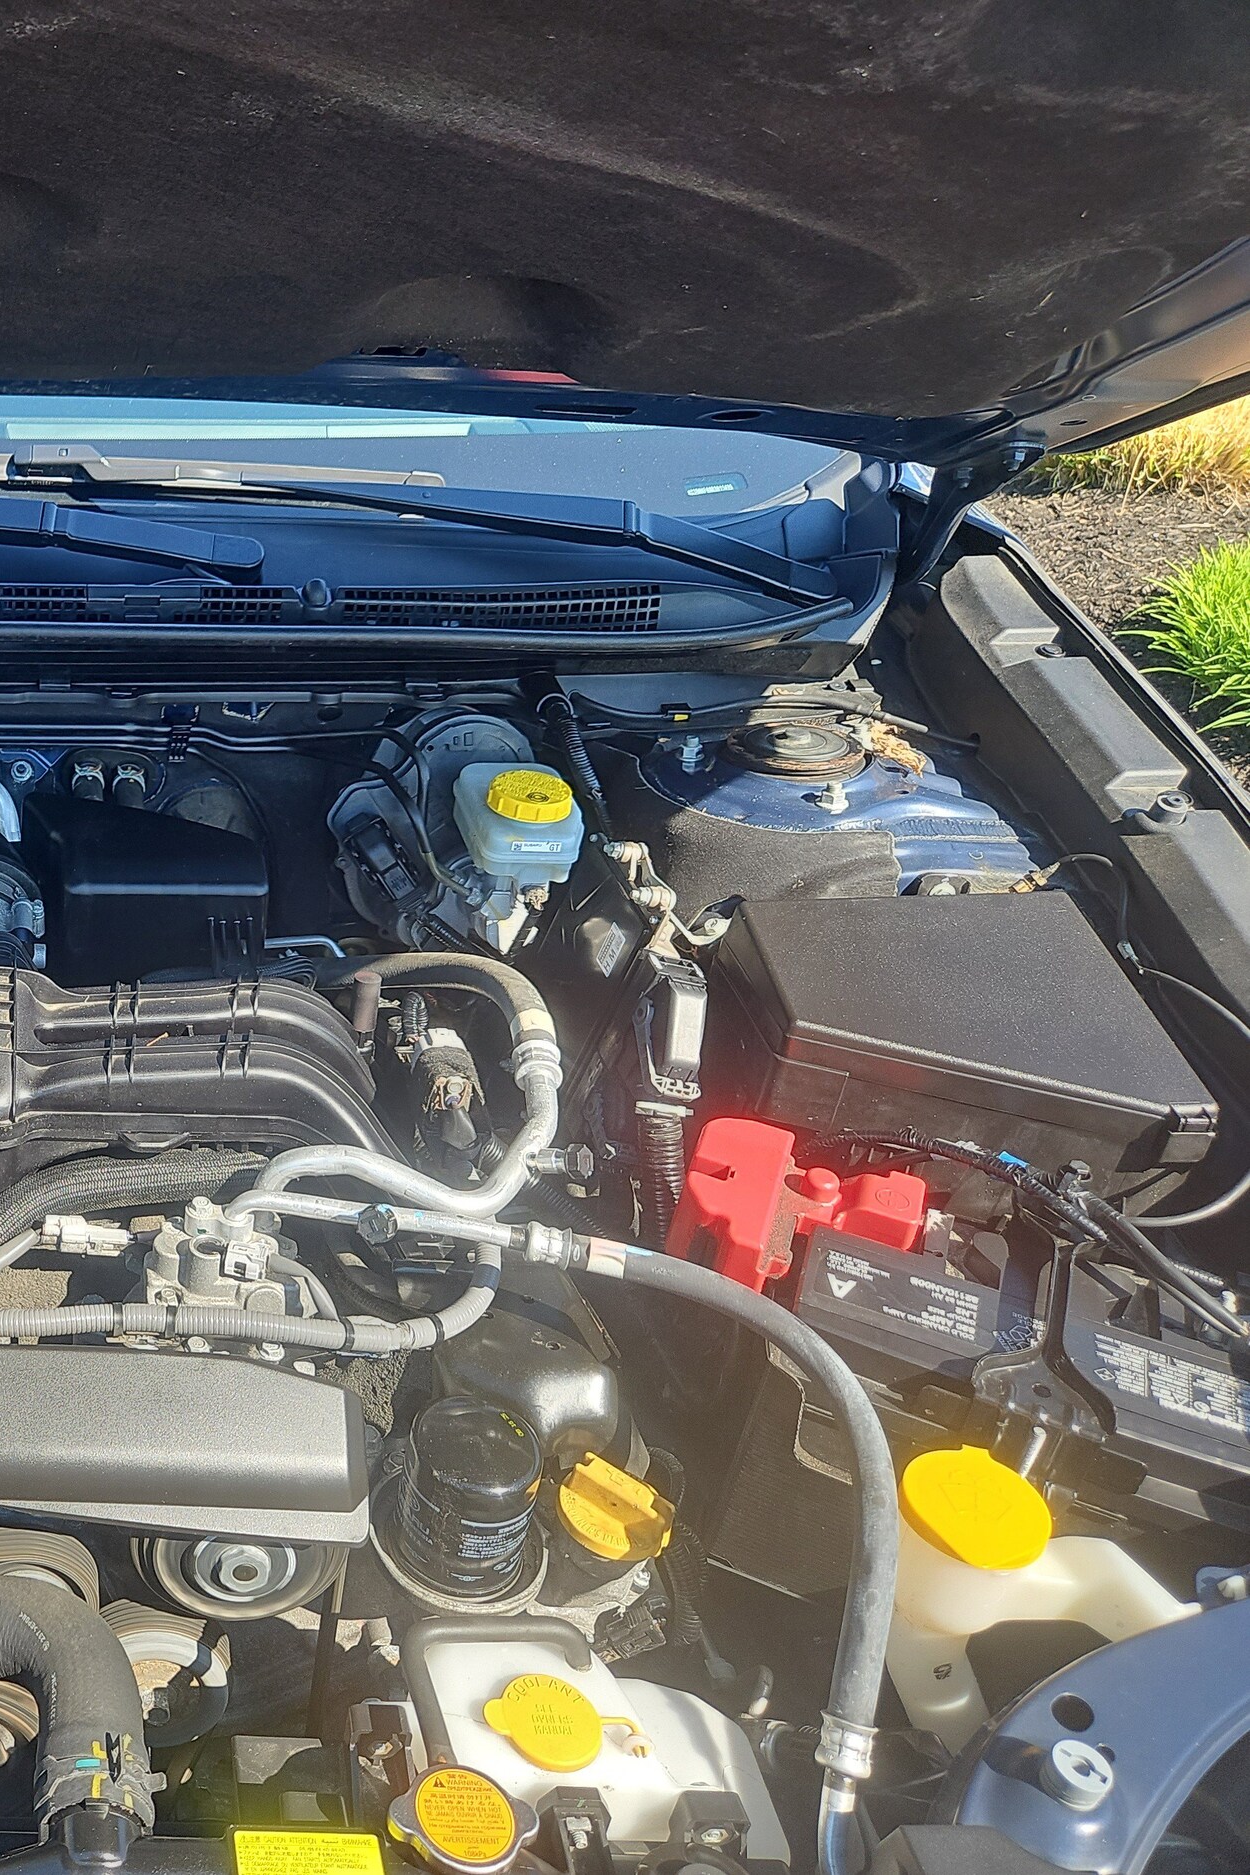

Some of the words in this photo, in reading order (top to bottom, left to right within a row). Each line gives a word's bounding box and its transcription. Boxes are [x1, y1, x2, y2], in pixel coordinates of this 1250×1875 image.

[549, 844, 561, 852] GT
[920, 1311, 954, 1327] AMPS
[446, 1779, 483, 1787] WARNING
[442, 1836, 500, 1845] AVERTISSEMENT
